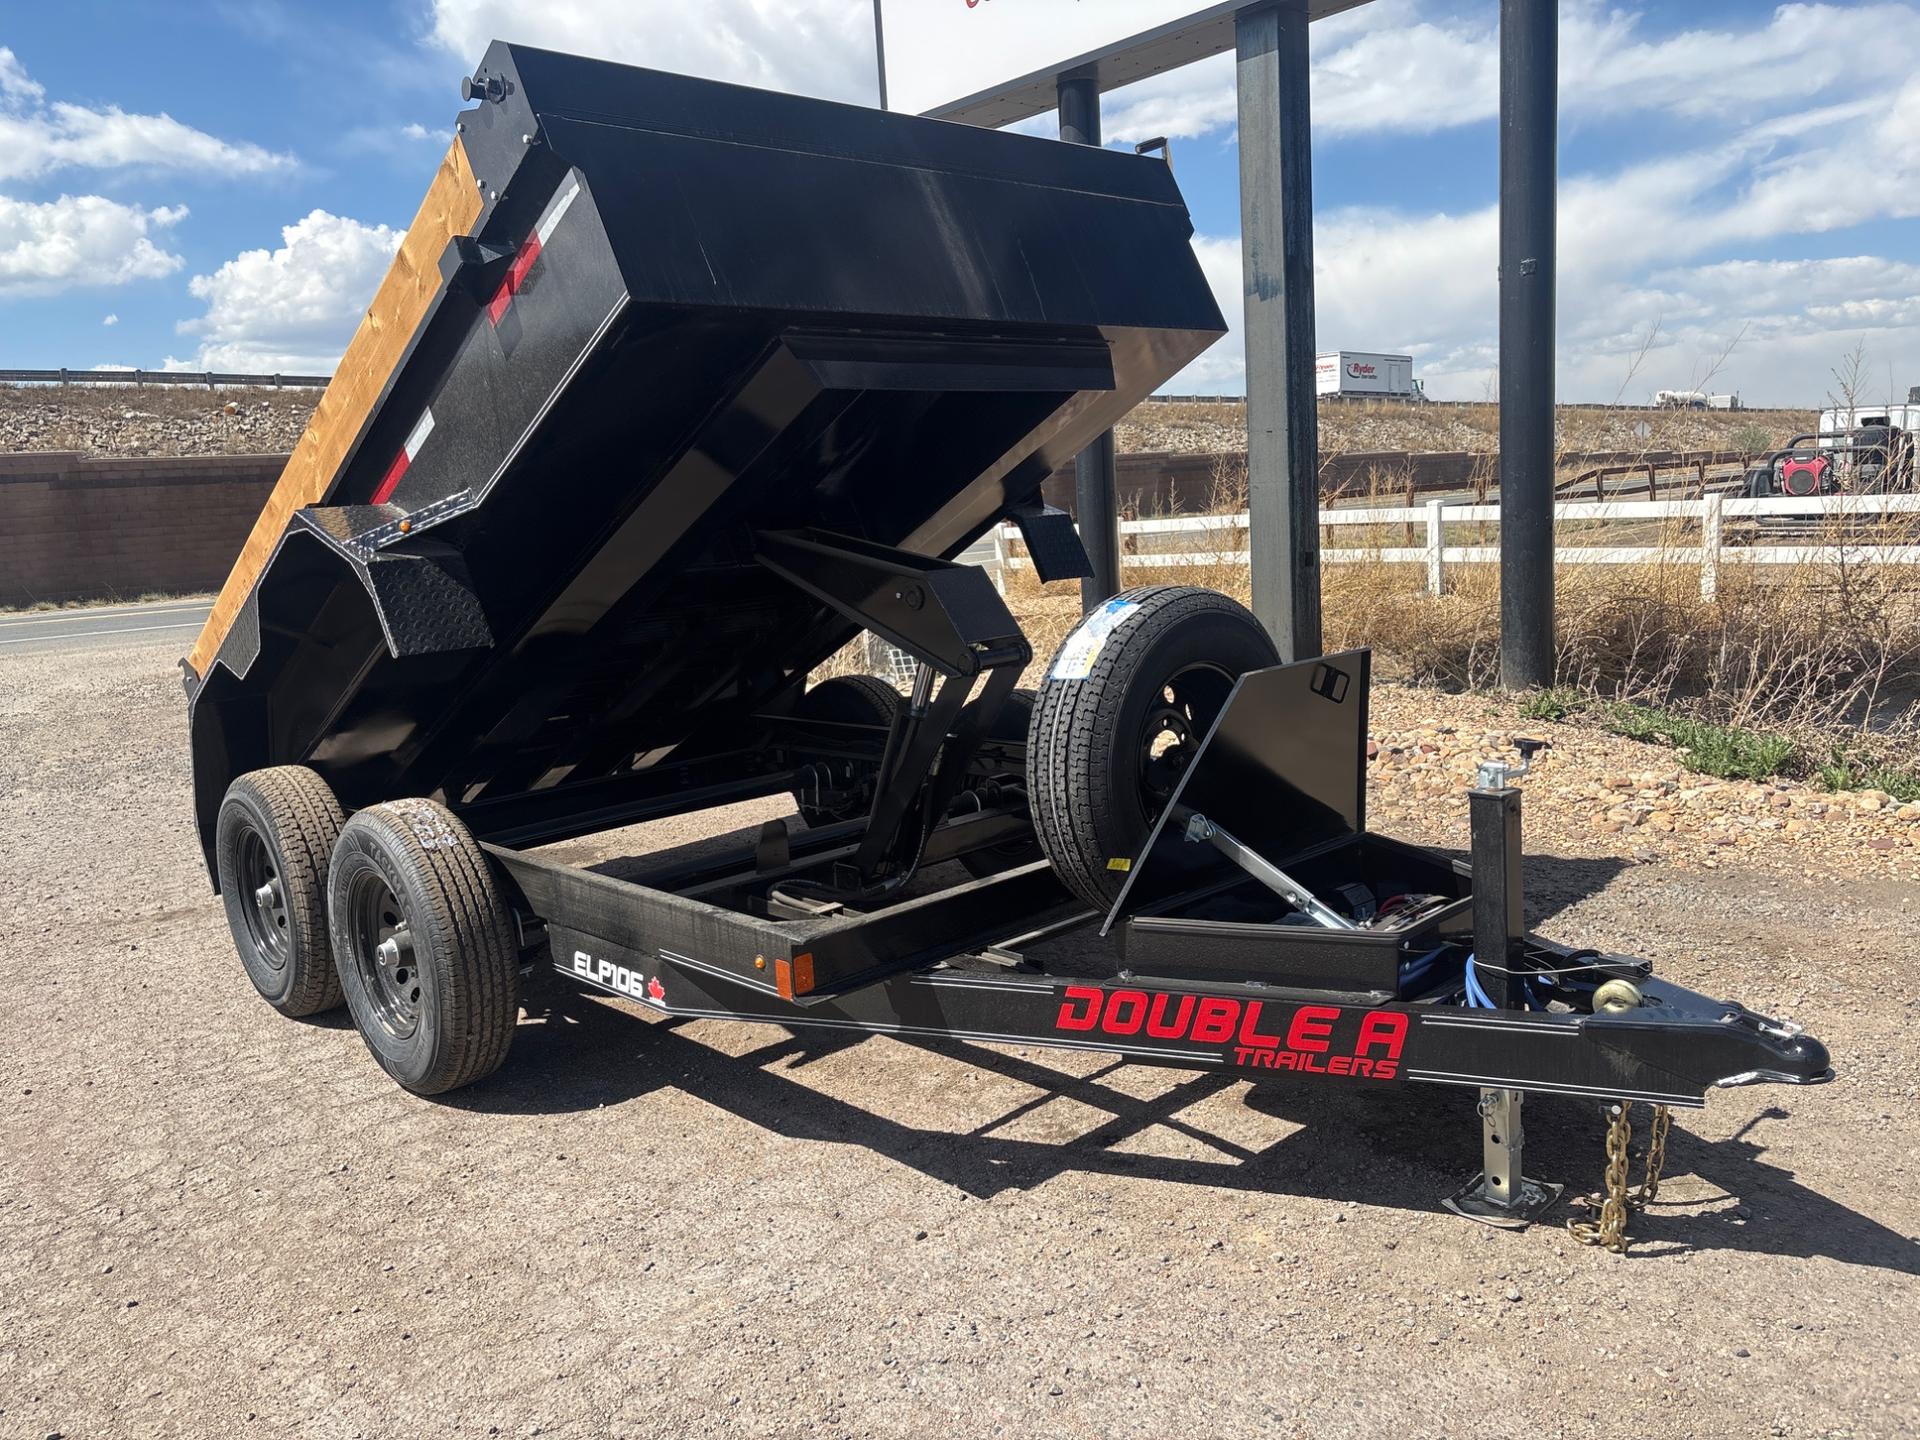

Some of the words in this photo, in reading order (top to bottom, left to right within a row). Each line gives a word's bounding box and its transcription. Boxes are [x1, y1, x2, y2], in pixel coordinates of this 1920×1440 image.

[1352, 362, 1376, 375] Ryder
[574, 951, 644, 998] ELP106
[1055, 986, 1342, 1053] DOUBLE
[1354, 1010, 1409, 1059] A
[1233, 1047, 1400, 1080] TRAILERS
